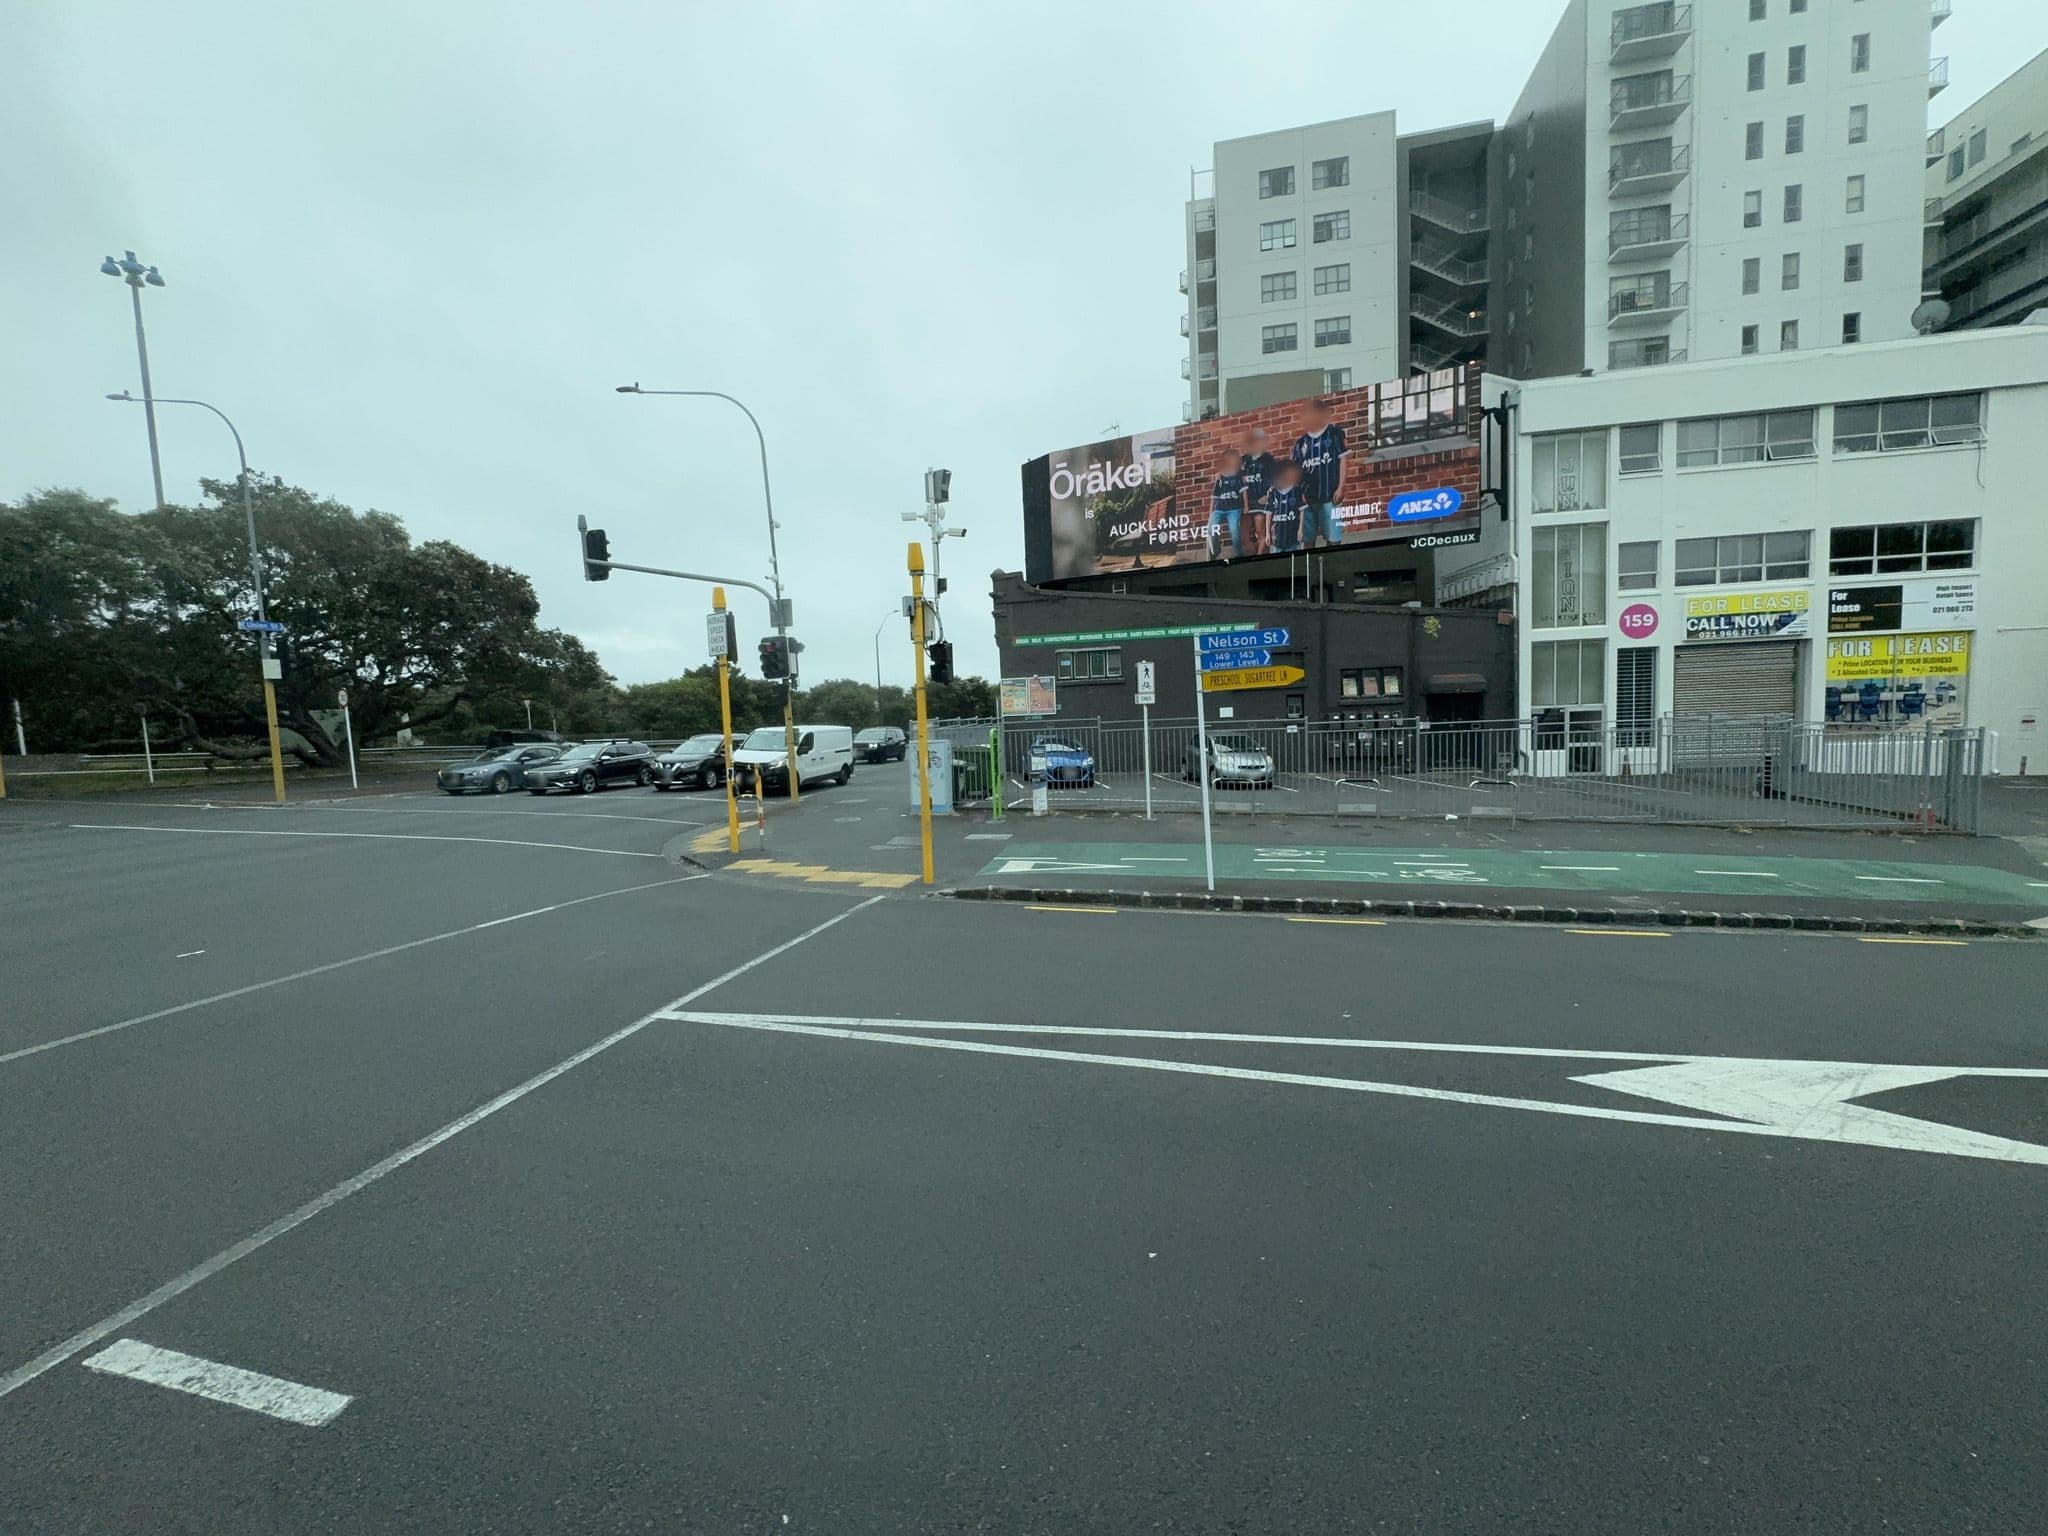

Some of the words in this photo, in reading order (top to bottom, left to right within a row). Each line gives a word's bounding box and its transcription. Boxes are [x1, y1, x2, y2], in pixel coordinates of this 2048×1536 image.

[1085, 508, 1094, 519] is
[1330, 503, 1370, 520] AUCKLAND
[1371, 501, 1382, 515] FC
[1398, 499, 1433, 516] ANZ
[1410, 533, 1476, 549] JCDecaux
[1831, 591, 1848, 600] For
[1688, 599, 1728, 614] FOR
[1741, 594, 1805, 611] LEASE
[1831, 604, 1861, 613] Lease
[1624, 614, 1654, 627] 159
[1687, 615, 1729, 631] CALL
[1734, 614, 1777, 629] NOW
[1208, 636, 1257, 648] Nelson
[1264, 632, 1278, 643] St
[1699, 631, 1717, 639] 021
[1741, 628, 1759, 636] 273
[1828, 640, 1872, 657] FOR
[1888, 635, 1964, 655] LEASE
[1215, 652, 1230, 660] 149
[1240, 651, 1254, 659] 143
[1861, 659, 1888, 667] LOCATION
[1922, 656, 1953, 664] BUSINESS
[1210, 661, 1234, 669] Lower
[1238, 657, 1259, 666] Level
[1210, 674, 1241, 687] PRESCHOOL
